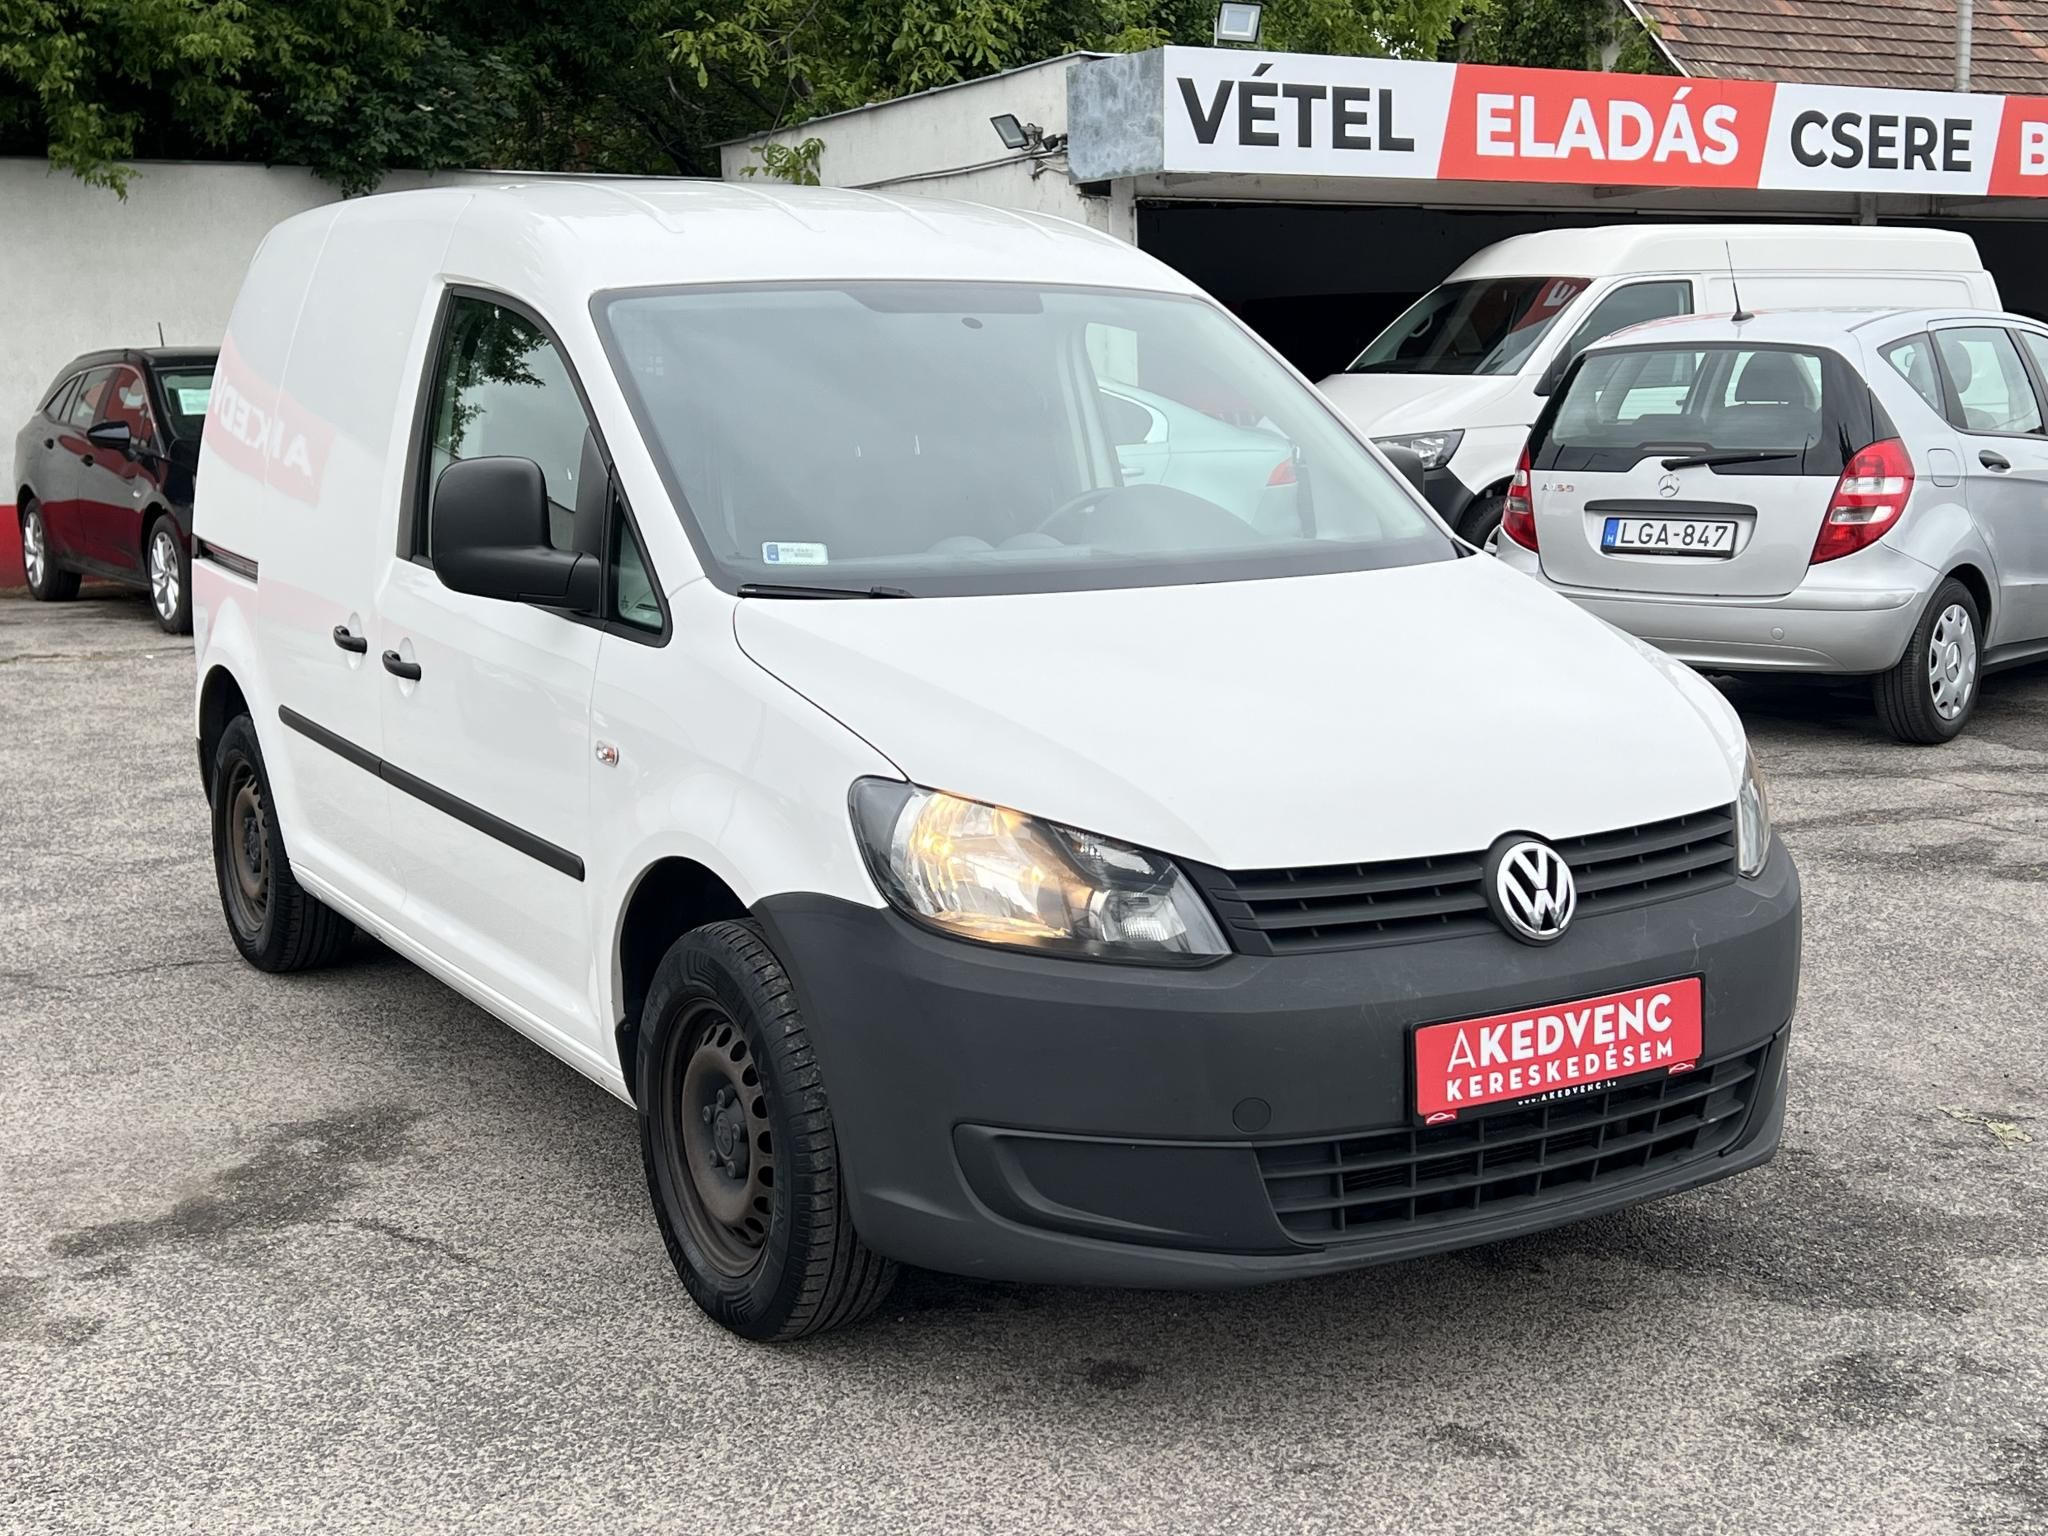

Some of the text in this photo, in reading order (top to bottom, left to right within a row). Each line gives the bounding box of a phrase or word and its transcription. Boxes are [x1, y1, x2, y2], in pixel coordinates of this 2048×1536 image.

[1176, 63, 1415, 153] VÉTEL
[1476, 86, 1739, 166] ELADÁS
[1790, 110, 1973, 173] CSERE
[1620, 522, 1728, 548] LGA-847
[1446, 1036, 1673, 1102] KERESKEDÉSEM
